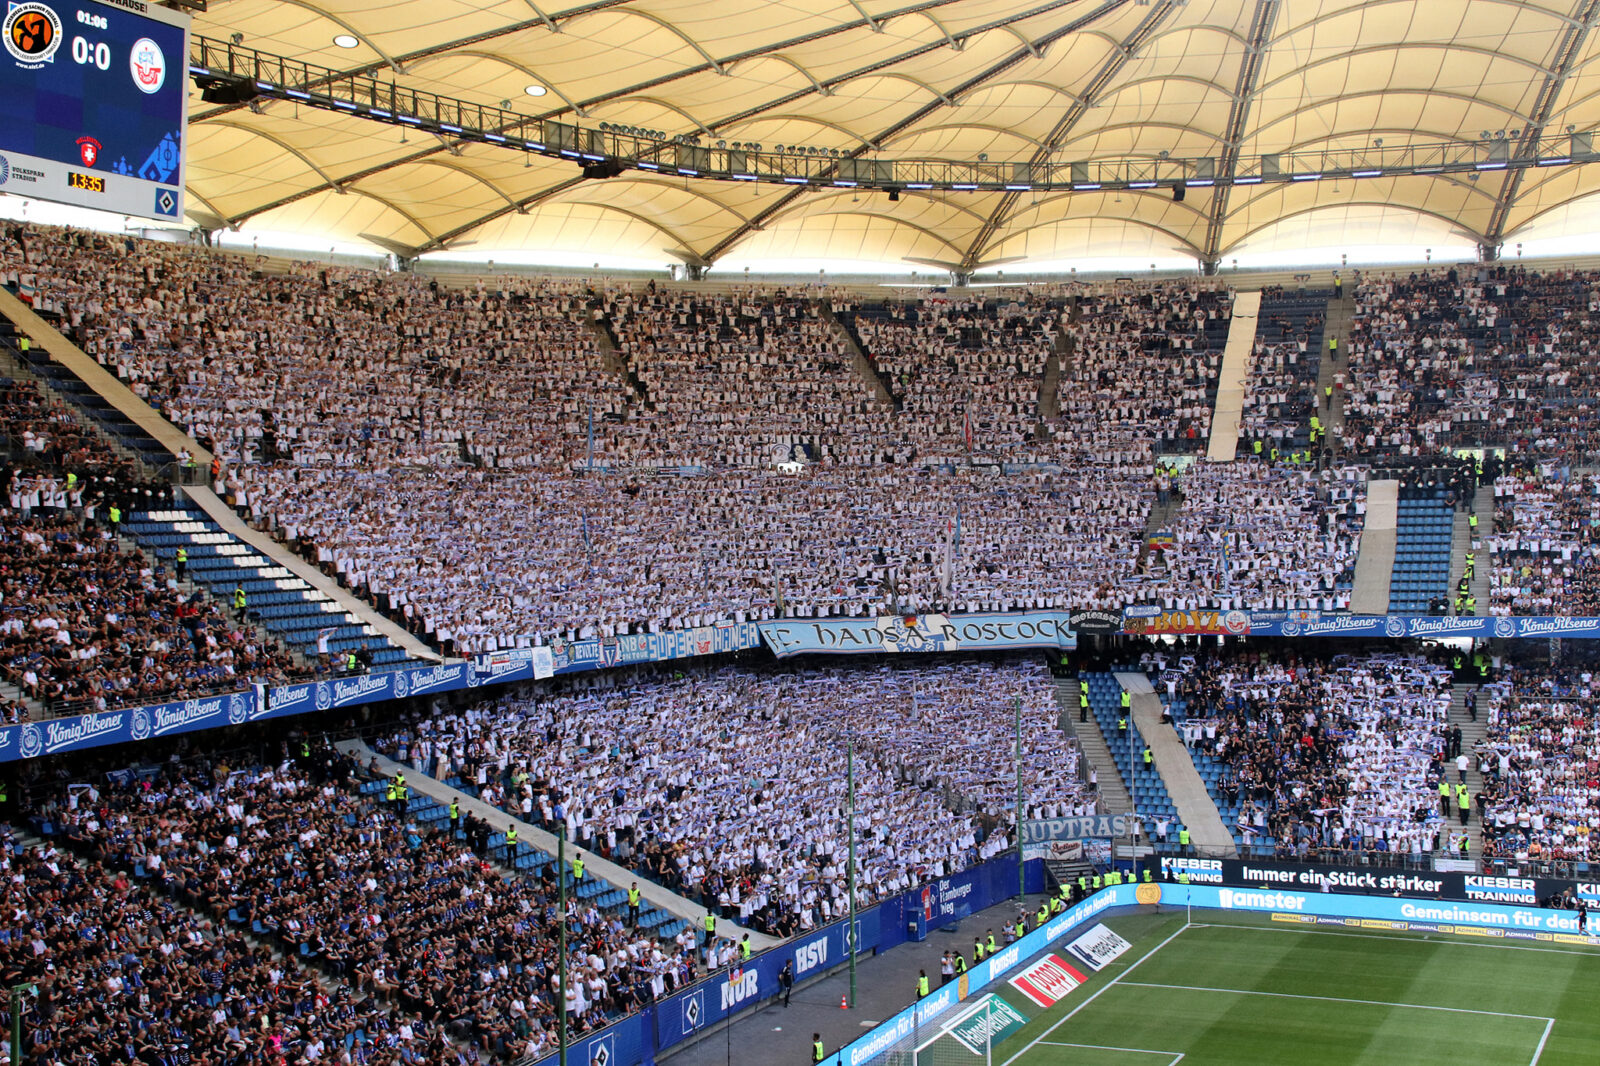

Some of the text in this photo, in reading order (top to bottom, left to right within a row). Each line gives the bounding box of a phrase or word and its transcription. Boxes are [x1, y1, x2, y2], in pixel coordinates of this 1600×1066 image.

[76, 10, 108, 30] 01:06
[72, 36, 111, 71] 0:0
[12, 166, 45, 178] VOLKSPARK
[12, 173, 37, 183] STADION
[72, 173, 102, 193] 13:35
[940, 619, 1075, 642] ROSTOCK
[1153, 610, 1221, 632] BOYZ
[1408, 616, 1485, 633] König Pilsener
[1518, 616, 1599, 633] König Pilsener
[648, 623, 759, 661] SUPER HANSA
[474, 654, 491, 673] LH
[410, 664, 462, 690] König Pilsener
[275, 685, 309, 706] Pilsener
[333, 674, 389, 702] König Pilsener
[153, 699, 222, 730] König Pilsener
[45, 713, 123, 747] König Pilsener
[1161, 857, 1223, 871] KIESER
[939, 879, 951, 892] Der
[1243, 866, 1443, 892] Immer ein Stück stärker
[1464, 875, 1536, 891] KIESER
[939, 883, 972, 904] Hamburger
[1465, 890, 1536, 904] TRAINING
[940, 902, 954, 915] Weg
[1046, 889, 1117, 941] Gemeinsam für den Handel!
[1400, 904, 1509, 925] Gemeinsam
[1512, 910, 1542, 927] für
[1546, 914, 1580, 930] den
[796, 936, 828, 974] HSV
[851, 1027, 897, 1065] Gemeinsam
[897, 1017, 909, 1036] für
[924, 990, 950, 1019] Handel!
